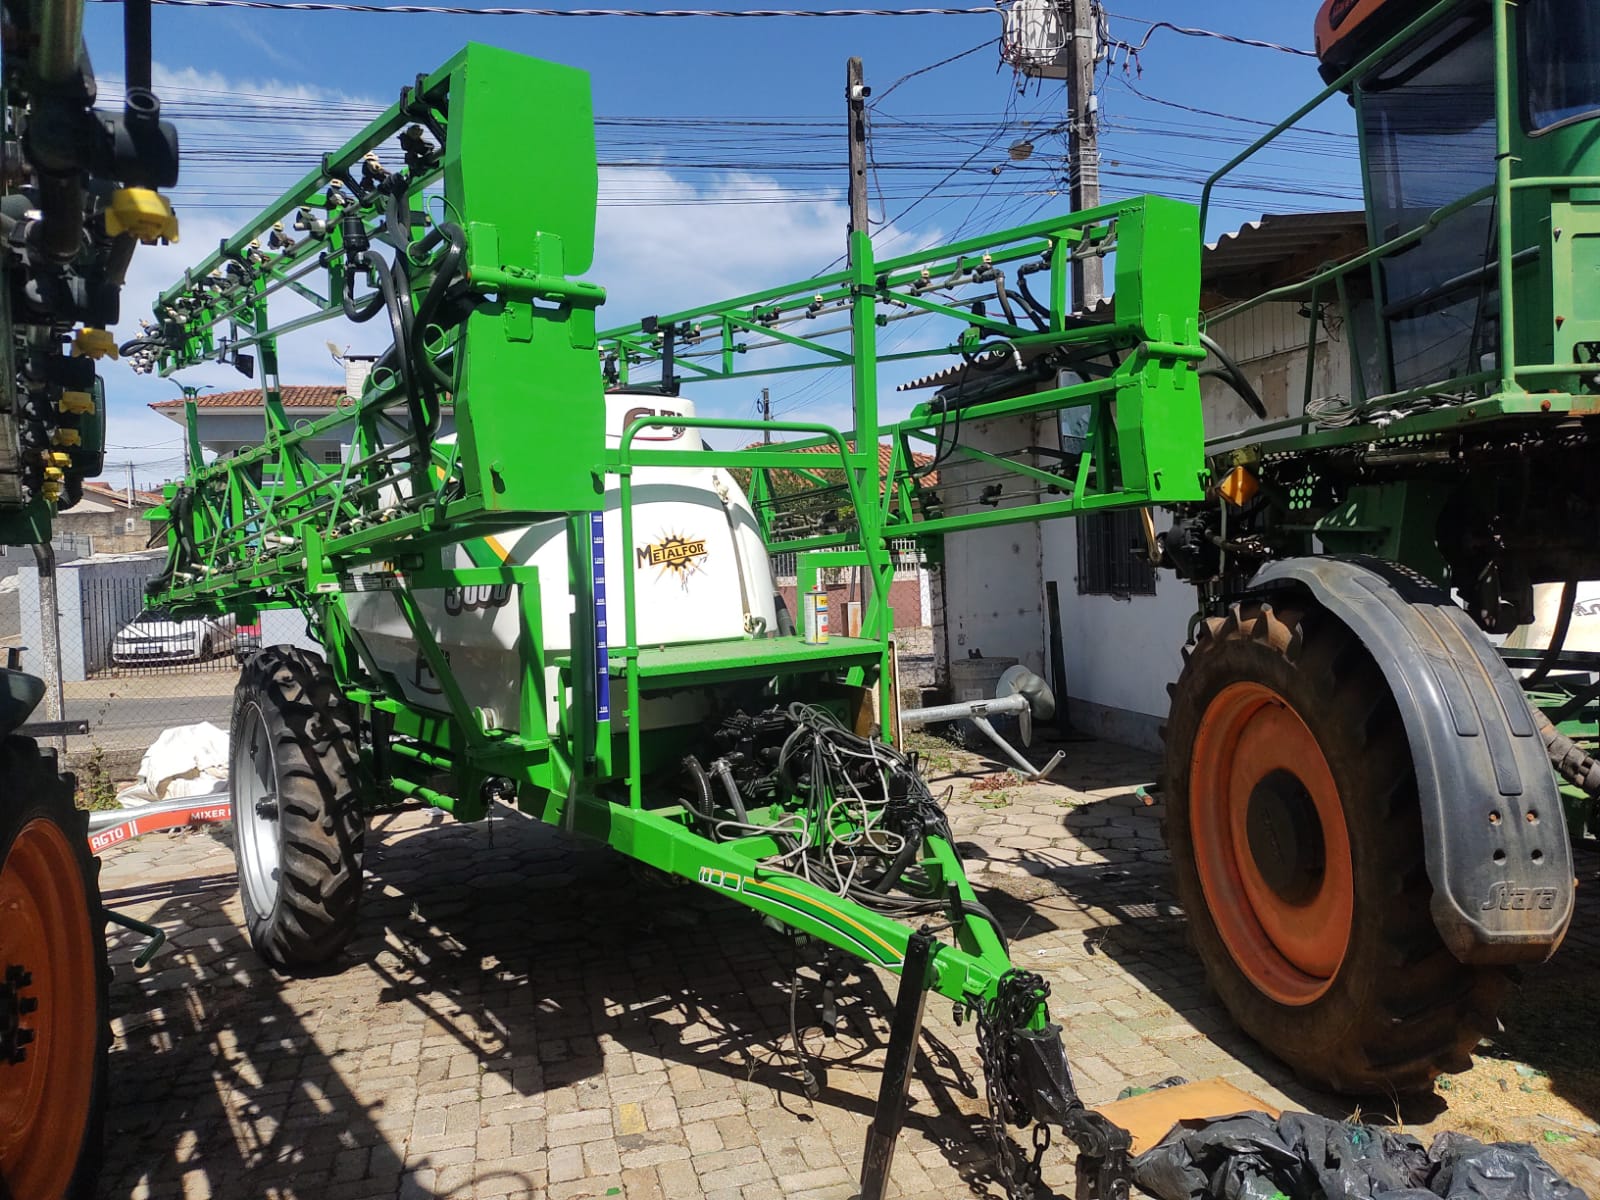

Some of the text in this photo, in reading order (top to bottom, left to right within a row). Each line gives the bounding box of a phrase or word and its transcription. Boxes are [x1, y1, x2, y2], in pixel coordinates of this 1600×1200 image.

[636, 543, 705, 569] METALFOR
[191, 808, 226, 821] MIXER
[1481, 881, 1558, 911] Stara
